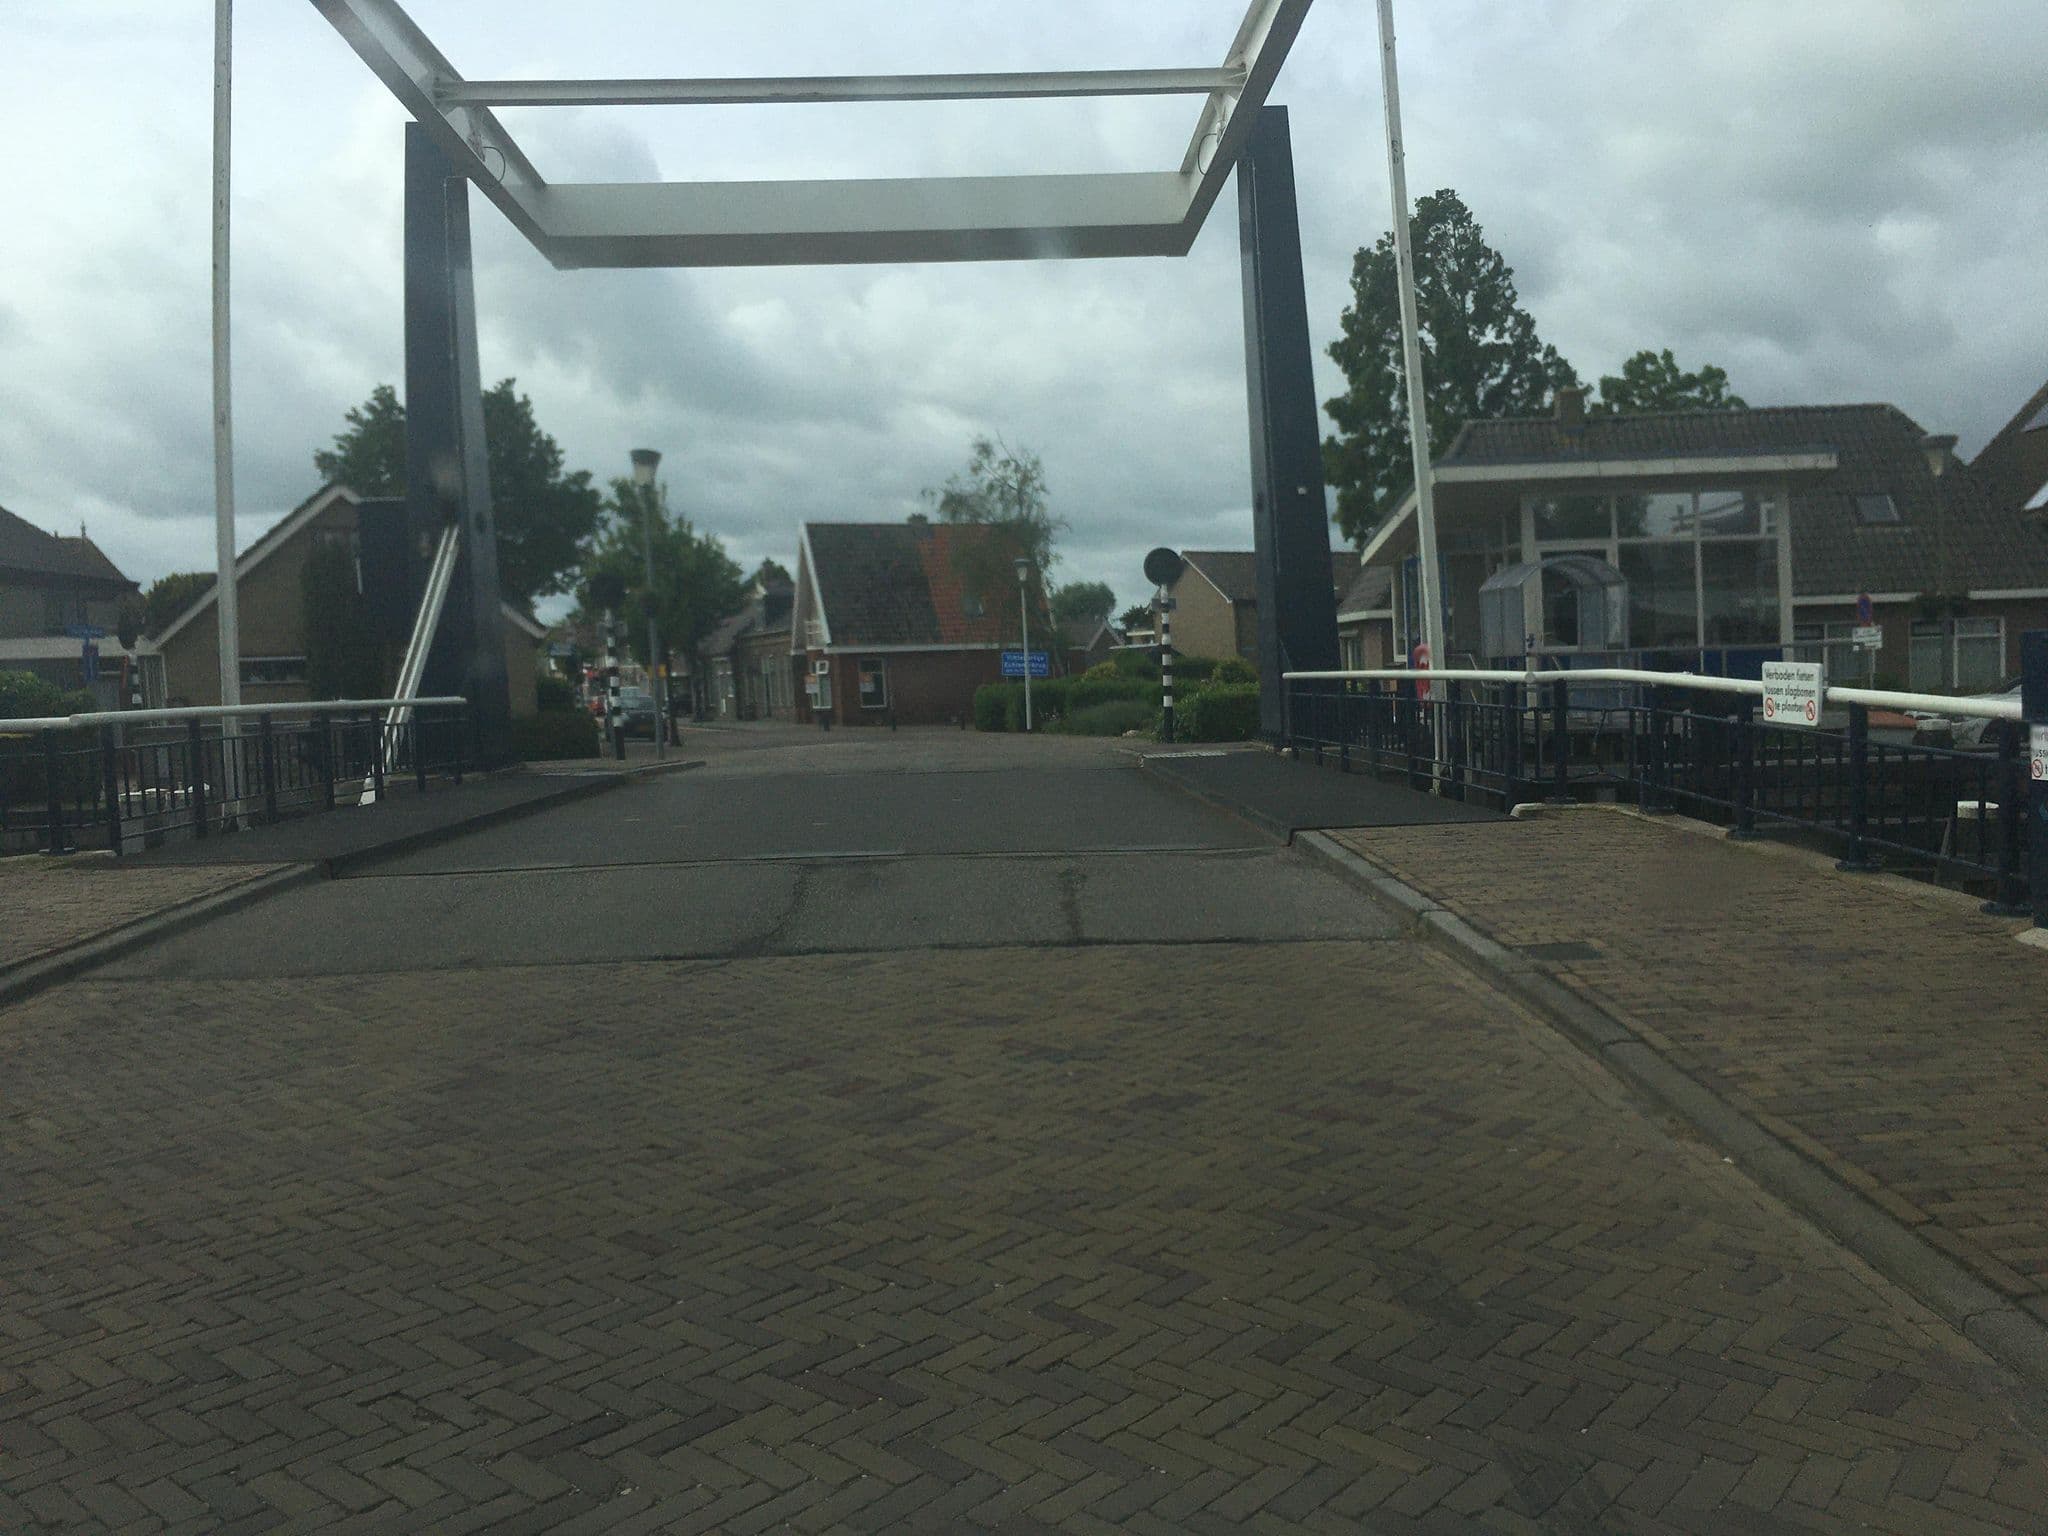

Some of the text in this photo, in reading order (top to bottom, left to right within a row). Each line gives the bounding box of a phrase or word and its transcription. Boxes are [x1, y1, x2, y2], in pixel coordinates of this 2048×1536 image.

[1764, 668, 1795, 681] Verboden
[1764, 684, 1816, 700] tussen slagbomen
[1775, 698, 1808, 714] te plaatse
